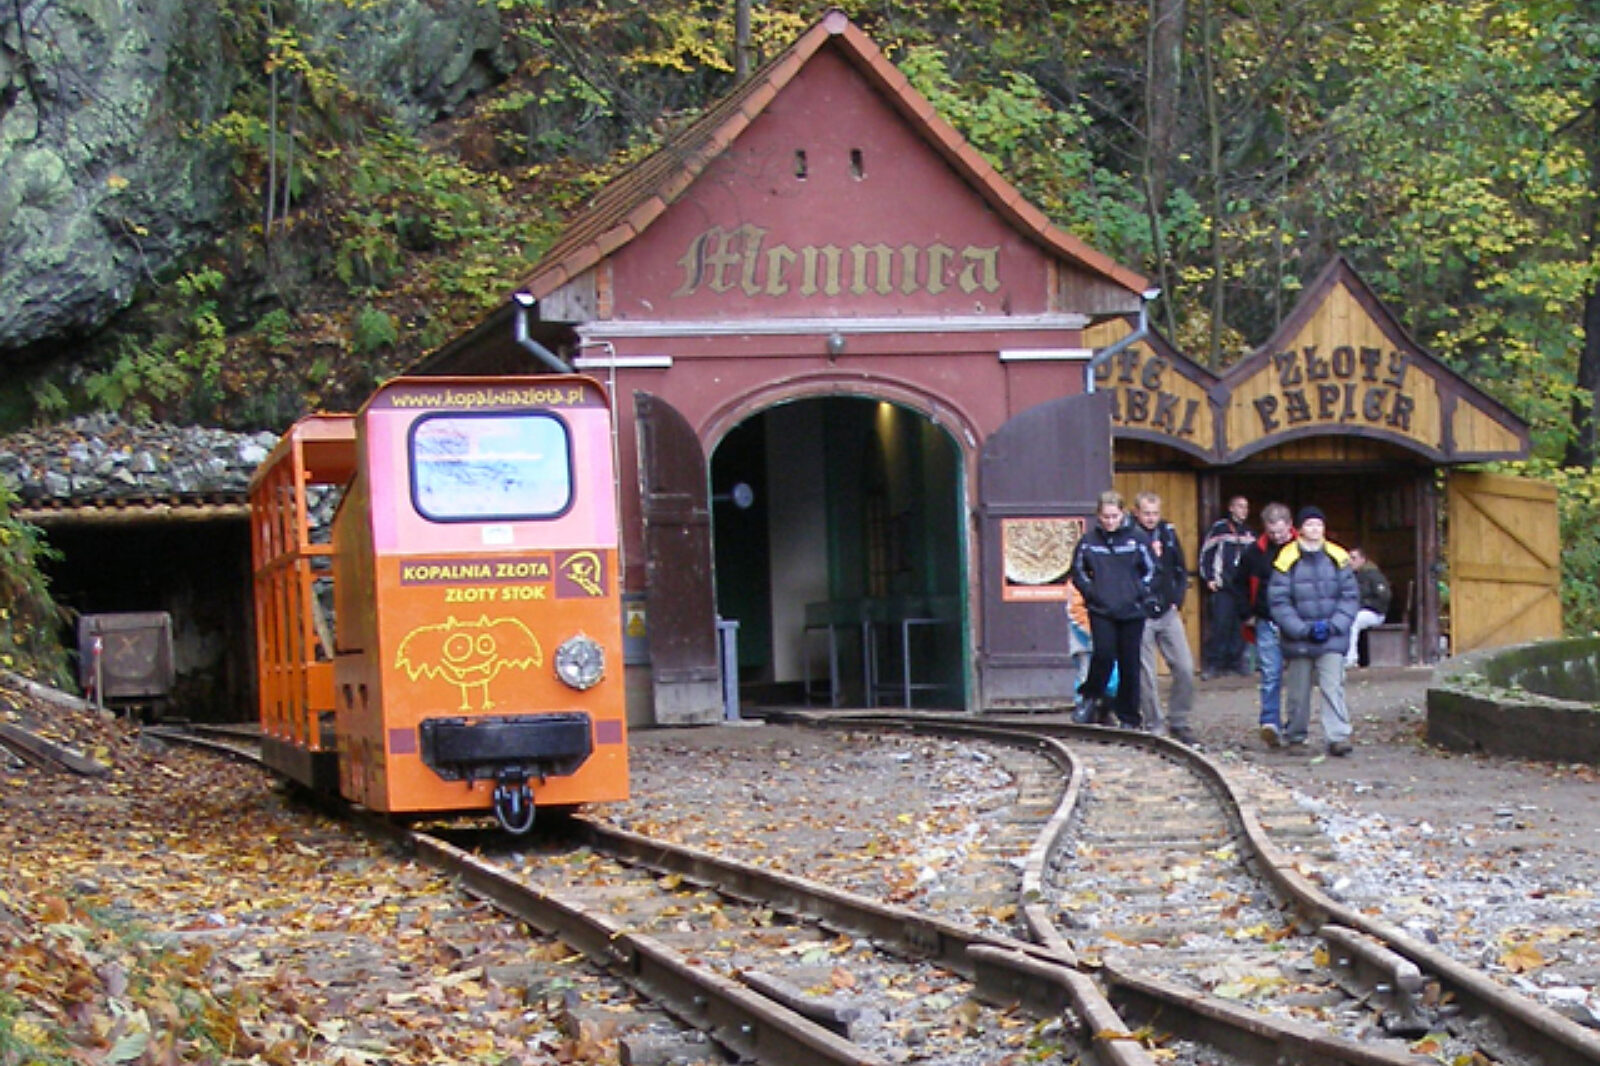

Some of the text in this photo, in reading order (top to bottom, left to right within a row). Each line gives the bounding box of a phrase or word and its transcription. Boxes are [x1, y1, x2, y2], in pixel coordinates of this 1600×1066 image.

[671, 223, 1000, 298] Mennica
[1253, 383, 1415, 432] PAPIER
[404, 565, 491, 580] KOPALNIA
[501, 585, 546, 600] STOK
